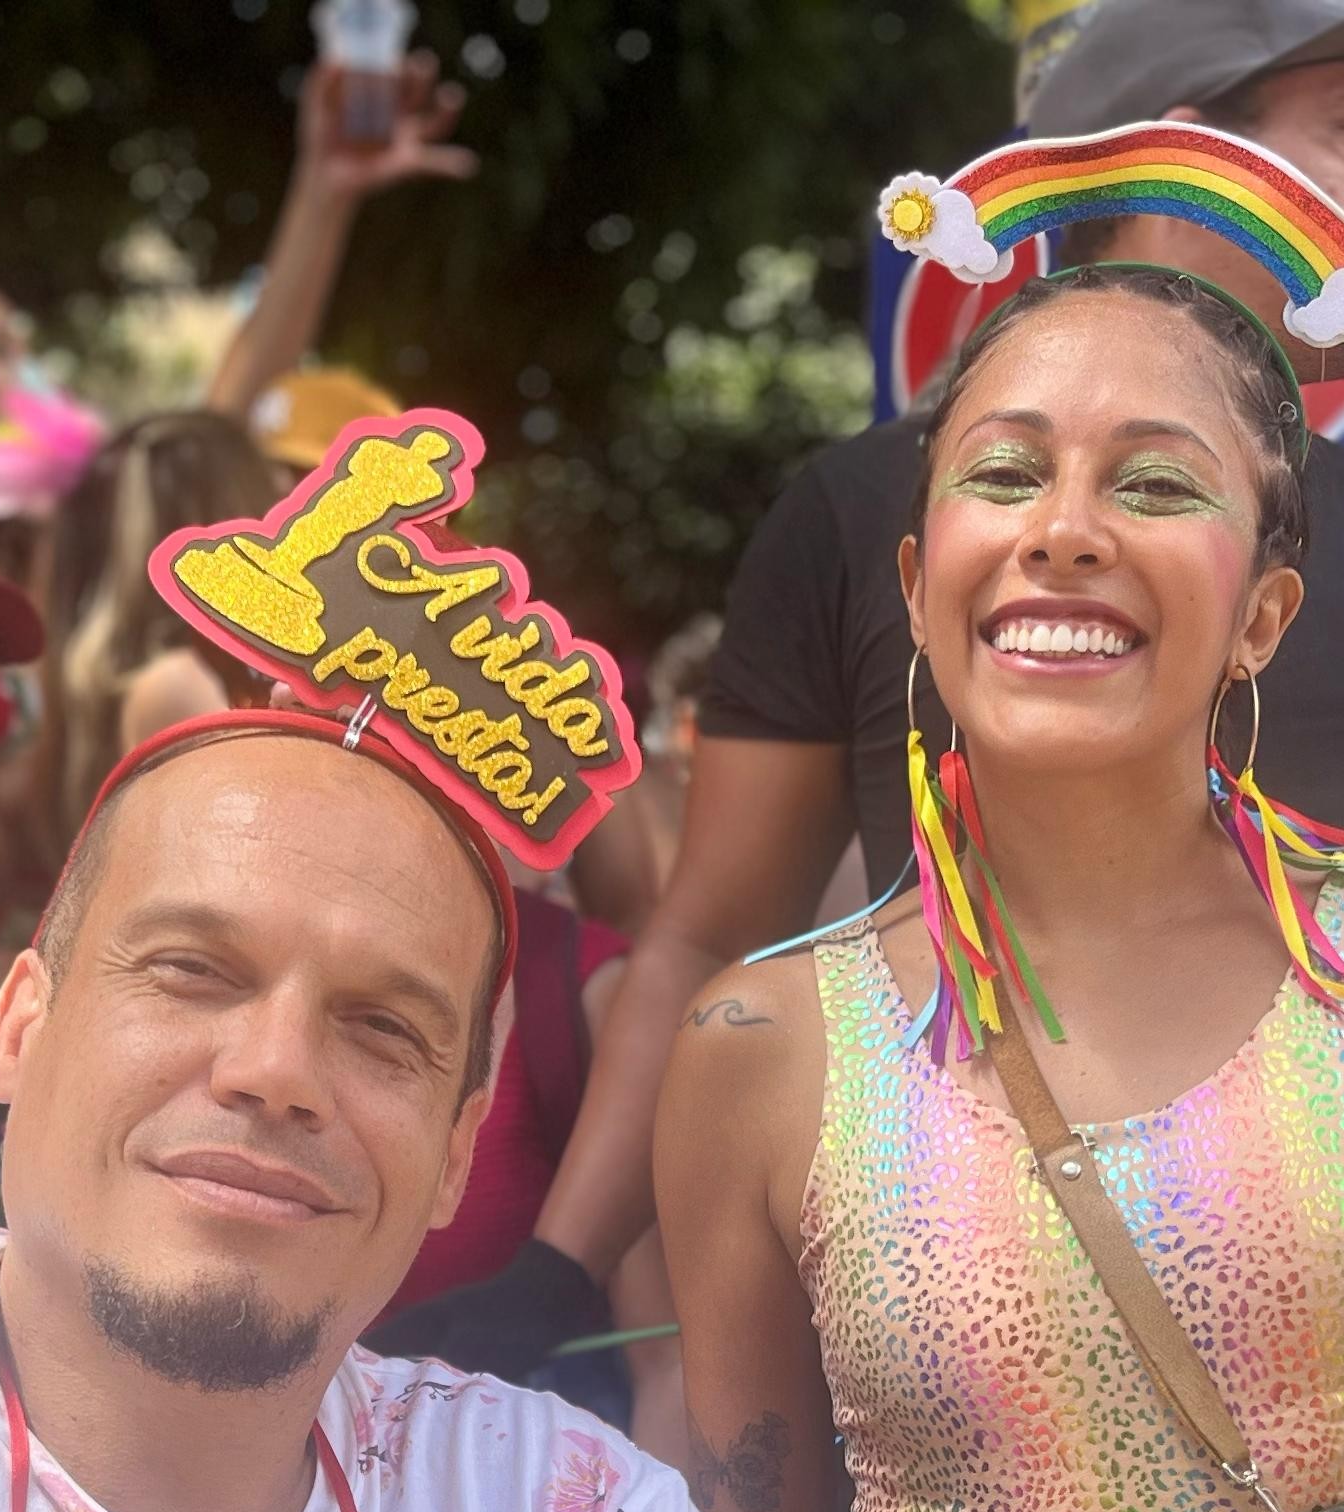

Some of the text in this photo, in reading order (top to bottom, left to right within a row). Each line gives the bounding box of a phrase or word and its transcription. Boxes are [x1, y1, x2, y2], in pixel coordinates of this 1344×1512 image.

[313, 627, 566, 825] presta!
[358, 534, 608, 756] A vida
